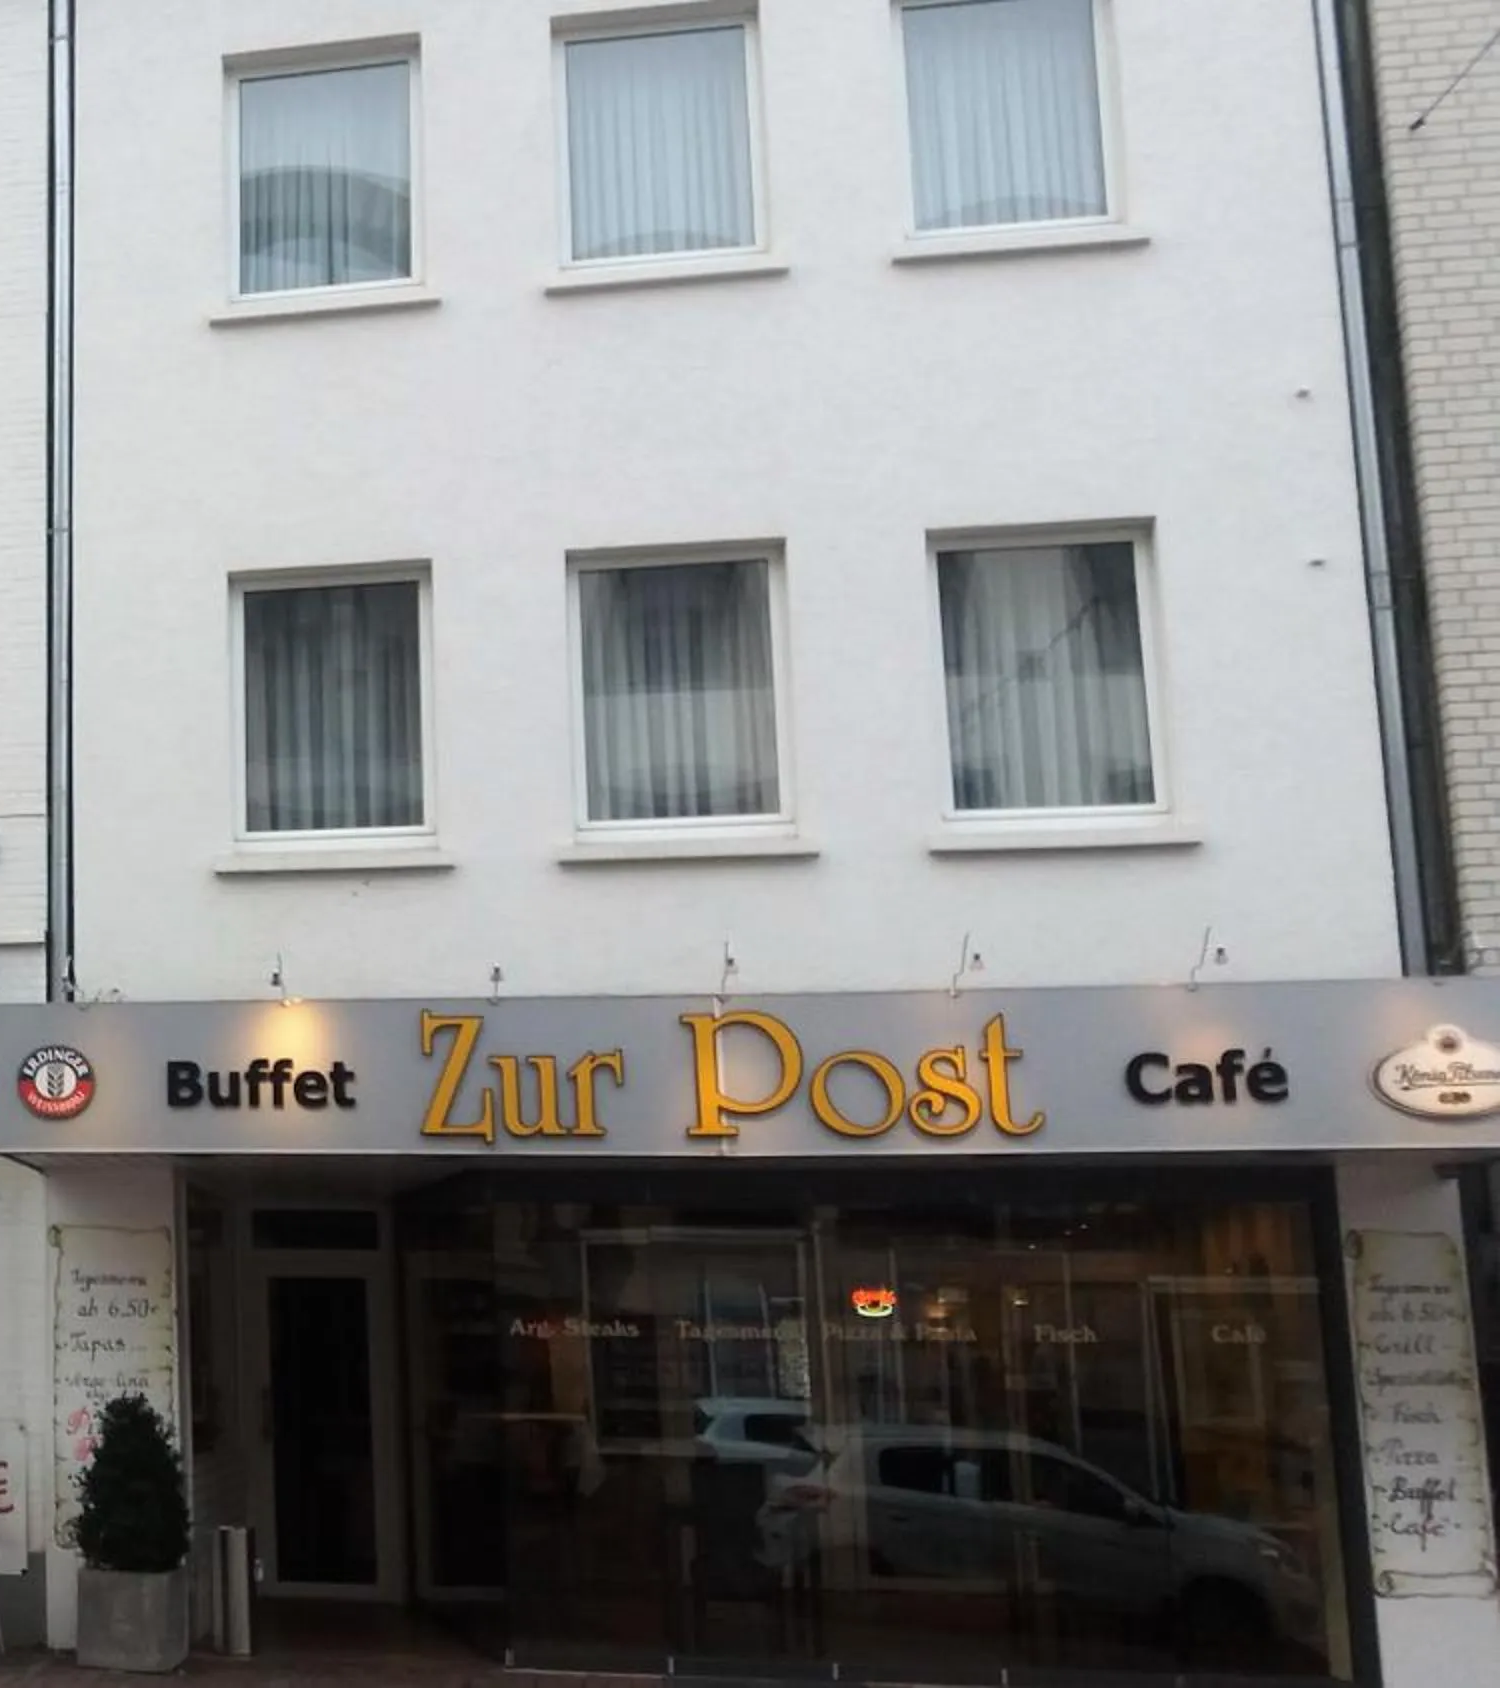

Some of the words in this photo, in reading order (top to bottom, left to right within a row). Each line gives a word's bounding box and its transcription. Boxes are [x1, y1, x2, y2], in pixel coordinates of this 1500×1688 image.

[22, 1047, 90, 1077] ERDINGER
[165, 1059, 357, 1110] Buffet
[419, 1008, 625, 1145] Zur
[678, 1009, 1047, 1139] Post
[1124, 1046, 1291, 1106] Café
